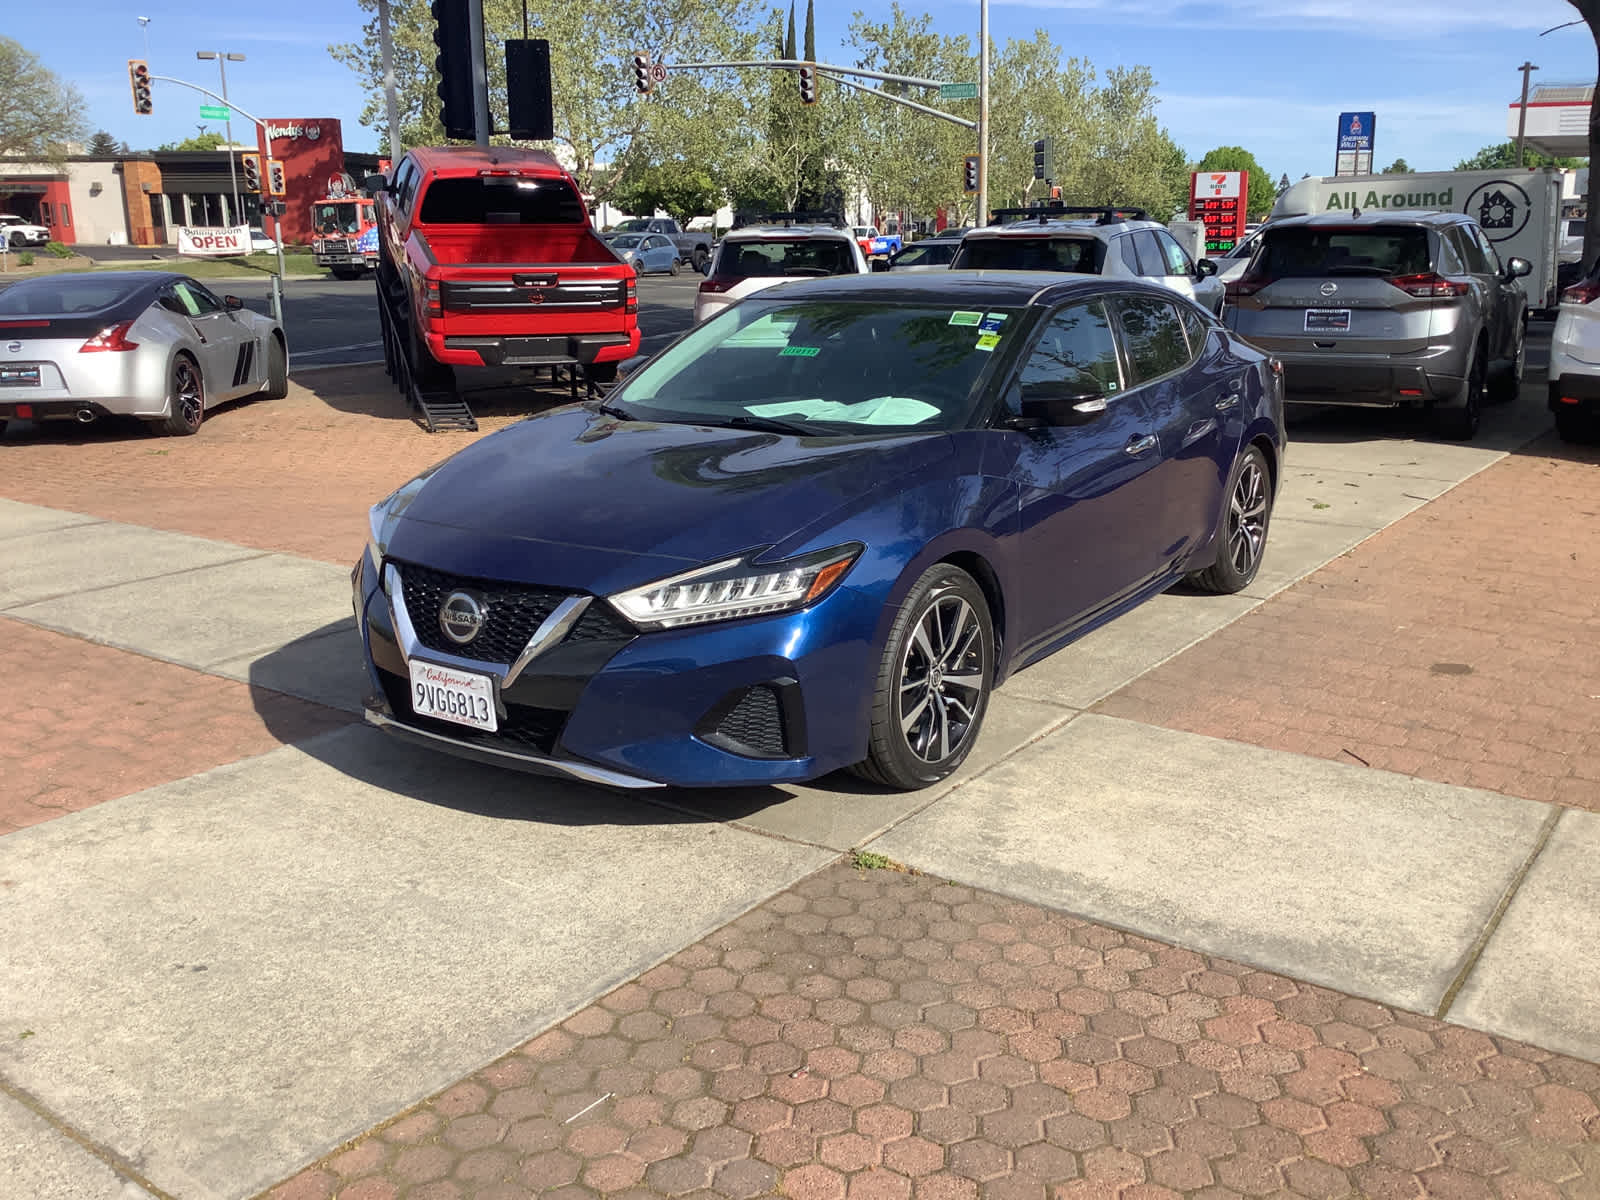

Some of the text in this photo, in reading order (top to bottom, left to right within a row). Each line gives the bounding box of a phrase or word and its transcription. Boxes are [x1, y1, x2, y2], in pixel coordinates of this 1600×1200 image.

[1326, 187, 1453, 210] All Around
[191, 235, 238, 248] OPEN
[441, 609, 480, 625] NISSAN
[427, 667, 476, 689] California
[416, 683, 489, 722] 9VGG813
